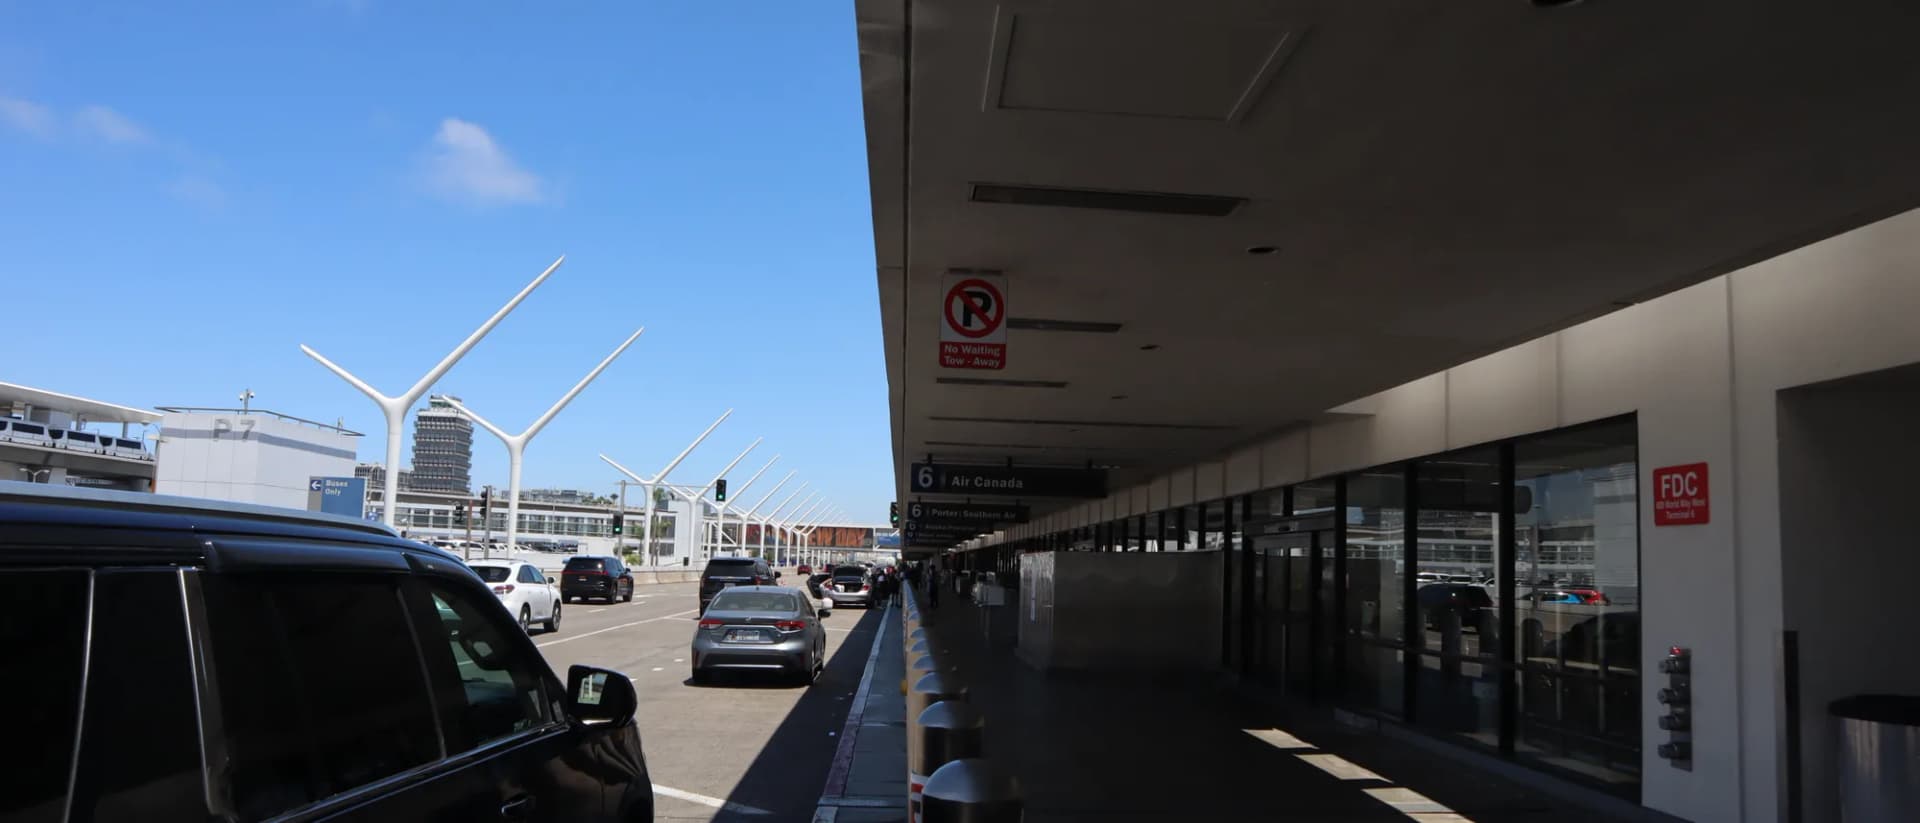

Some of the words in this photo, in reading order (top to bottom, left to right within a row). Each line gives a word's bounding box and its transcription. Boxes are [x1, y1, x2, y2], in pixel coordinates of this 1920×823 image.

[944, 344, 958, 354] No
[962, 344, 1000, 357] Waiting
[944, 356, 964, 365] Tow
[974, 357, 1001, 368] Away
[213, 418, 232, 442] P
[240, 419, 256, 442] 7
[325, 479, 348, 487] Buses
[918, 466, 933, 488] 6
[951, 476, 970, 487] Air
[974, 476, 1024, 489] Canada
[1661, 471, 1697, 498] FDC
[325, 488, 341, 496] Only
[911, 503, 922, 518] 6
[931, 507, 958, 518] Porter
[963, 508, 1002, 519] Southern
